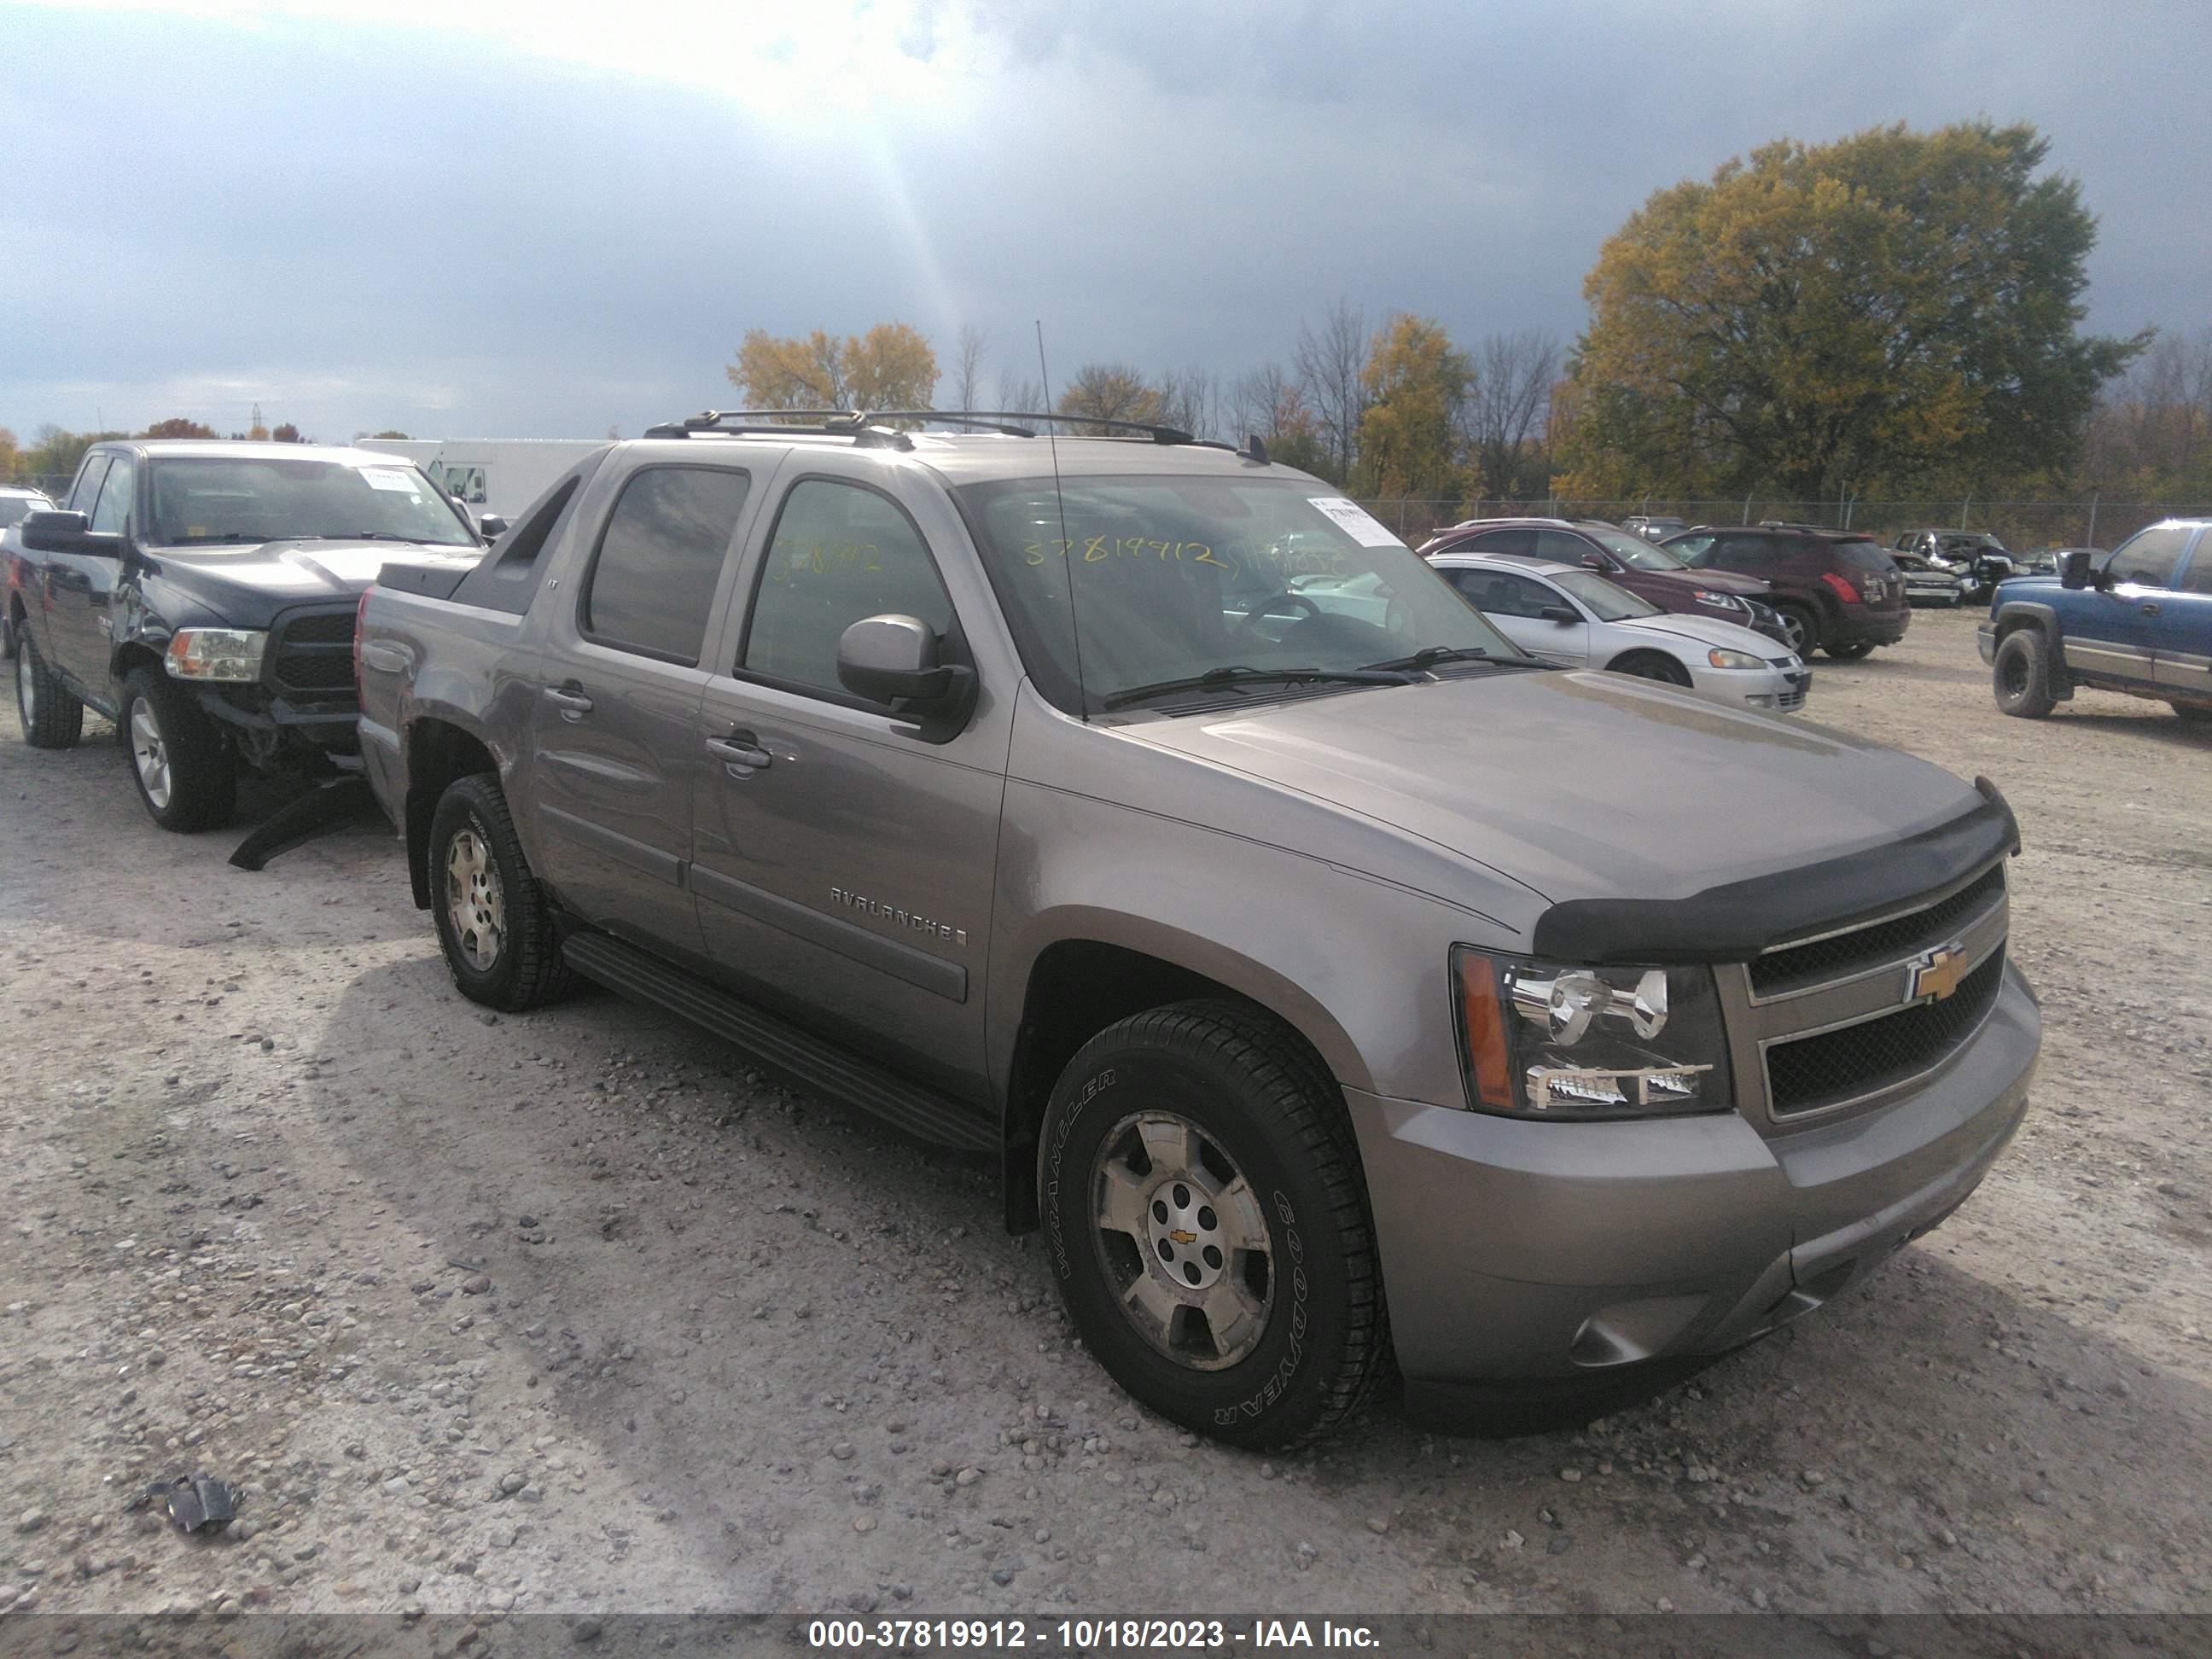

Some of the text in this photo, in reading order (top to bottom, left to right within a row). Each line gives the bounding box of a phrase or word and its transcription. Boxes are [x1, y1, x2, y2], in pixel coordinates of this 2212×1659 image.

[1020, 533, 1228, 569] 37819912
[830, 887, 953, 941] AVALANCHE
[1046, 1068, 1117, 1280] WRANGLER
[1214, 1190, 1308, 1426] GOODYEAR
